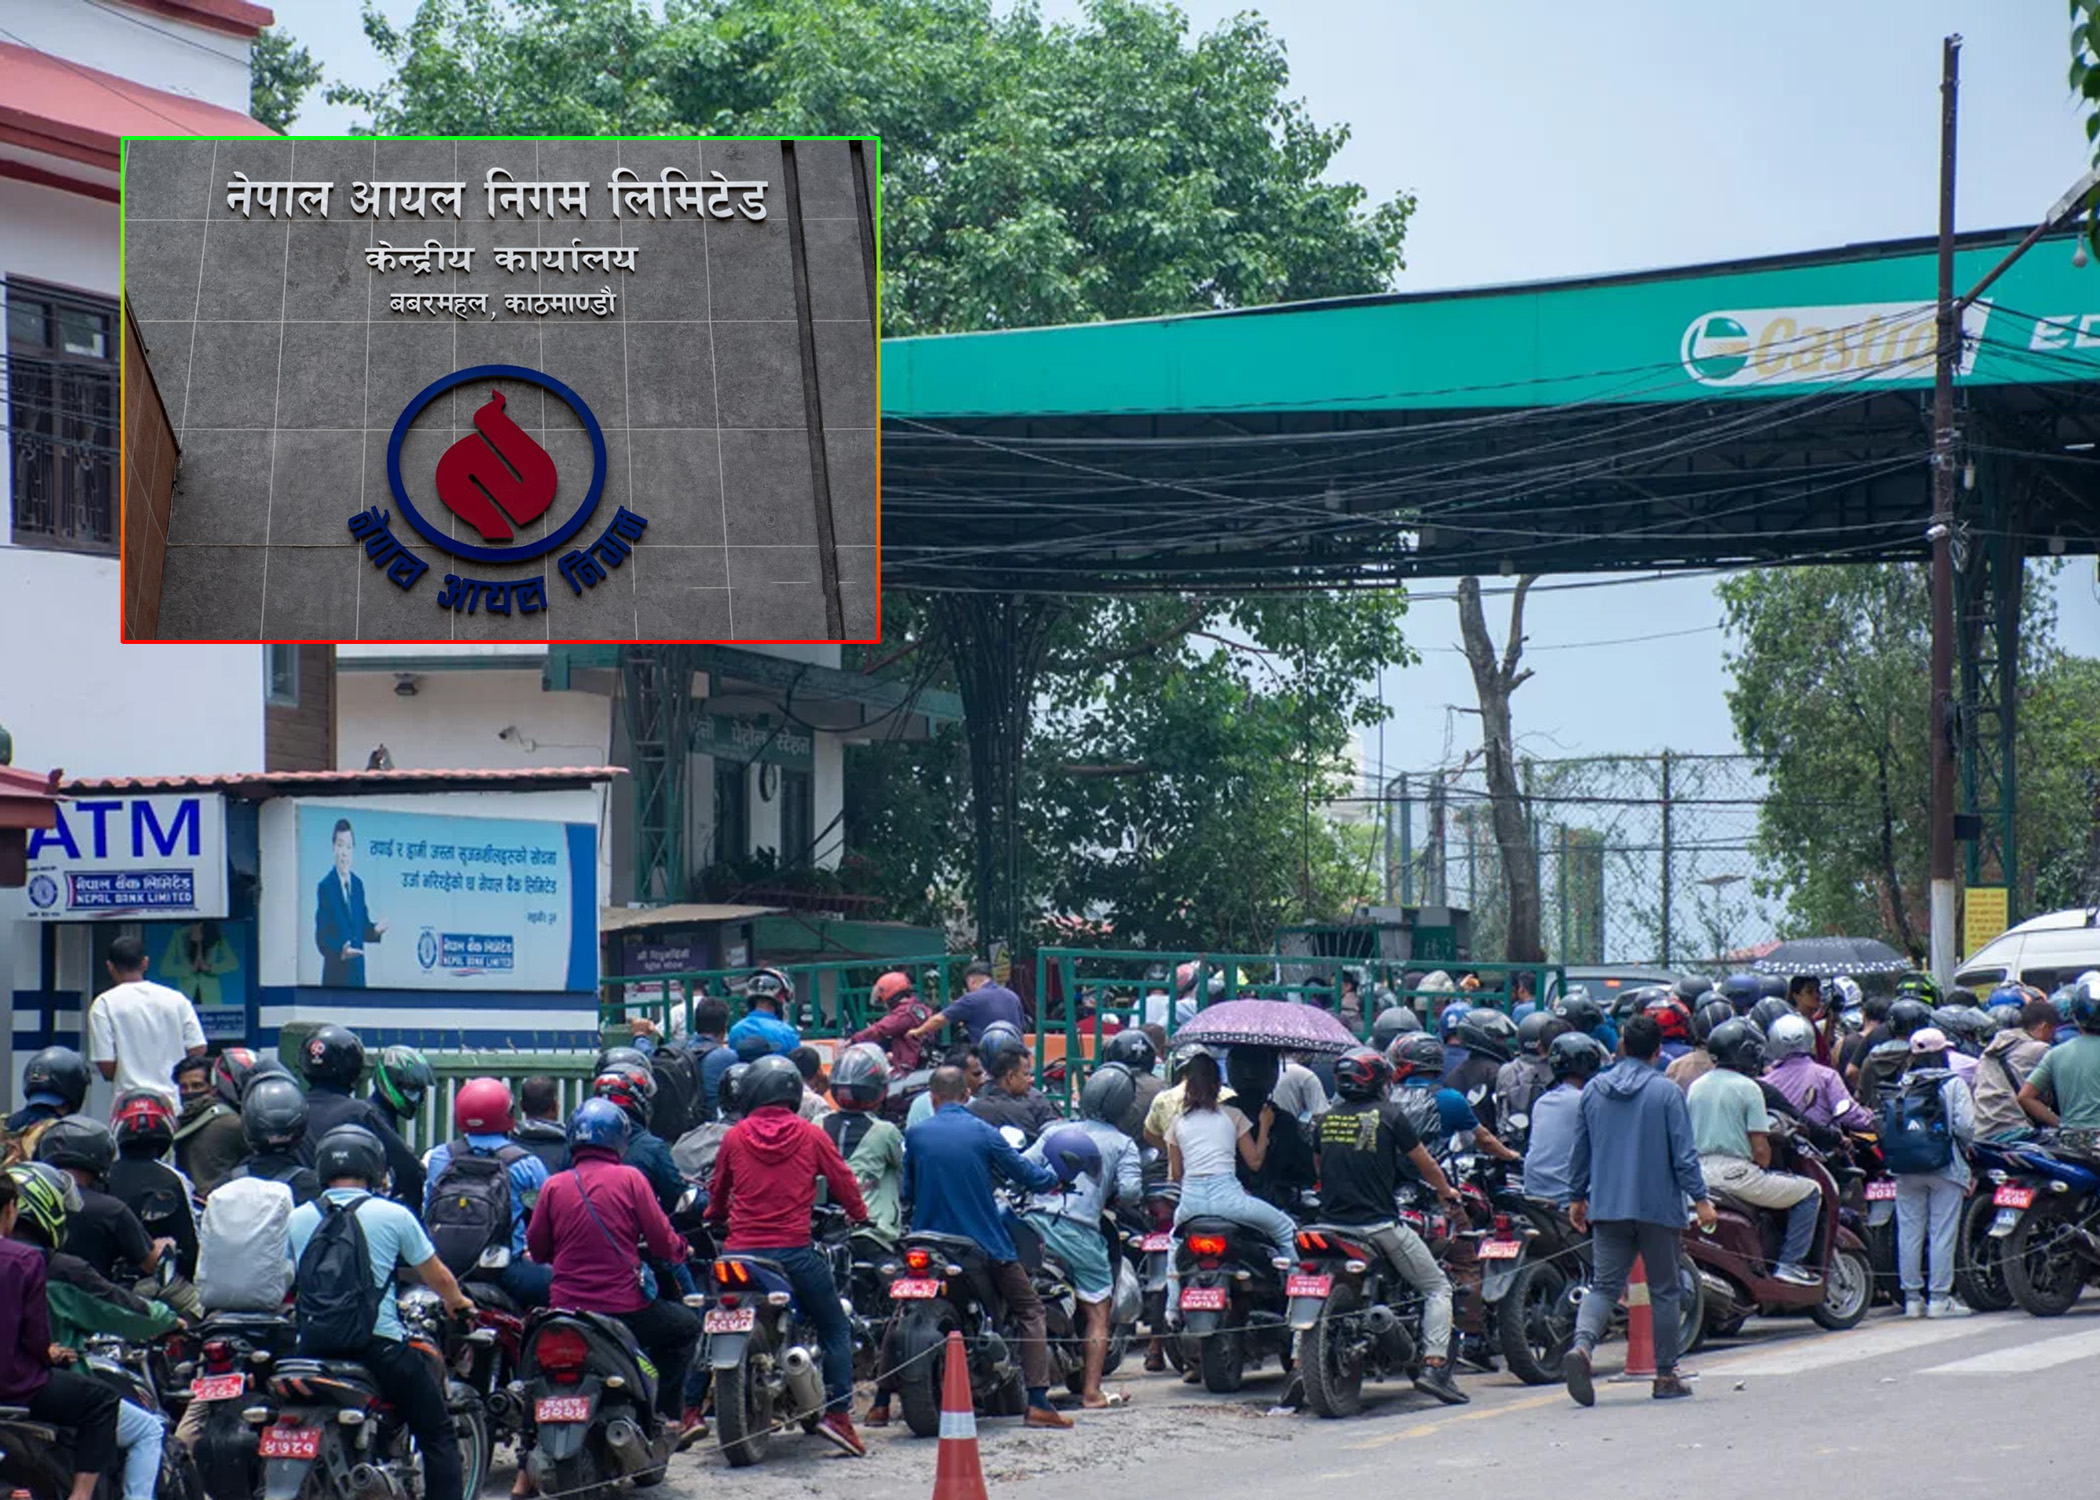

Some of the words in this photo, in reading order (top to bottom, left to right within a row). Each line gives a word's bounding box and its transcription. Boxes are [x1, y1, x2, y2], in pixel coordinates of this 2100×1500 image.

[226, 171, 334, 220] नेपाल
[350, 181, 467, 220] आयल
[483, 166, 590, 220] निगम
[607, 166, 770, 222] लिमिटेड
[365, 239, 476, 275] केन्द्रीय
[493, 237, 640, 273] कार्यालय
[504, 285, 617, 318] काठमाण्डौ
[1754, 314, 1939, 376] Castro
[347, 505, 430, 592] नेपाल
[437, 573, 549, 615] आयल
[27, 798, 201, 860] ATM
[76, 894, 112, 904] NEPAL
[115, 893, 145, 904] BANK
[147, 892, 192, 903] LIMITED
